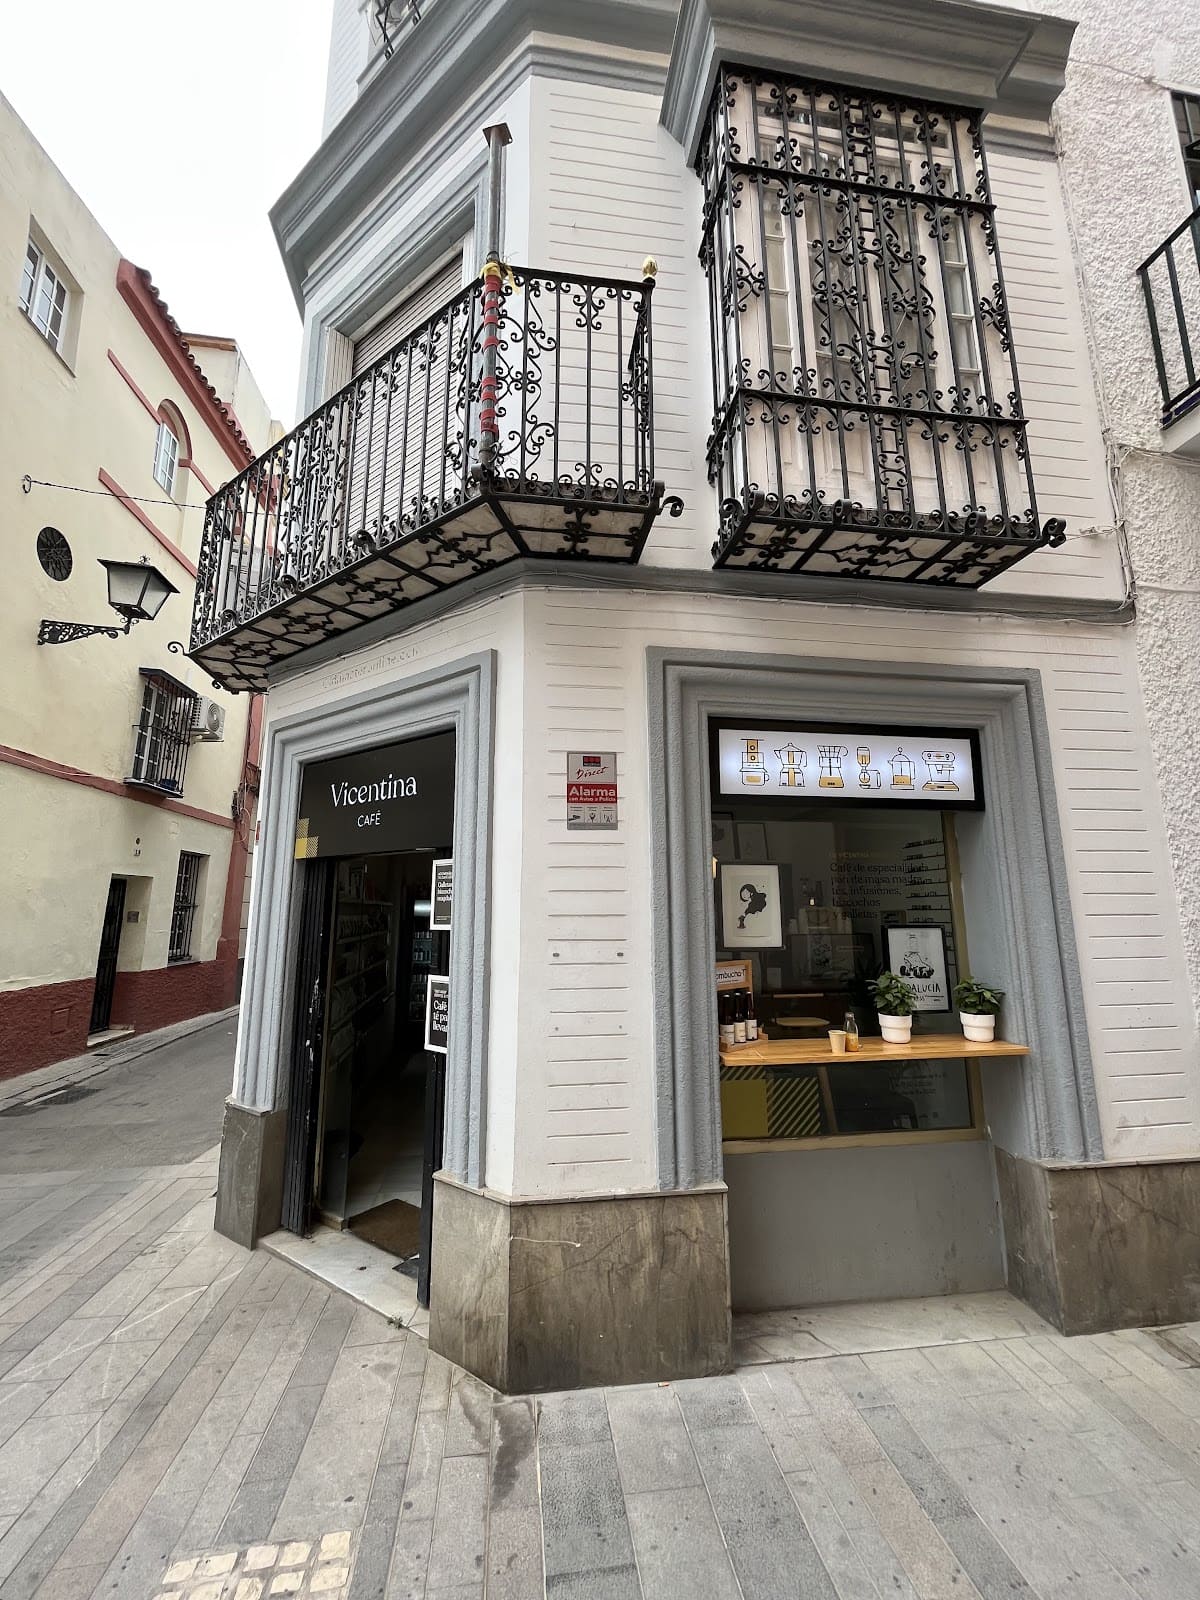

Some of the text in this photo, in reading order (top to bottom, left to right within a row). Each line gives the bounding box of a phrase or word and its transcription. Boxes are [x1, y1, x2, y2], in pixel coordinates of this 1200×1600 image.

[575, 766, 609, 780] Direct
[331, 773, 417, 807] Vicentina
[569, 785, 616, 797] Alarma
[357, 810, 381, 828] CAFÉ
[433, 1000, 448, 1011] Café
[439, 1013, 449, 1023] pa
